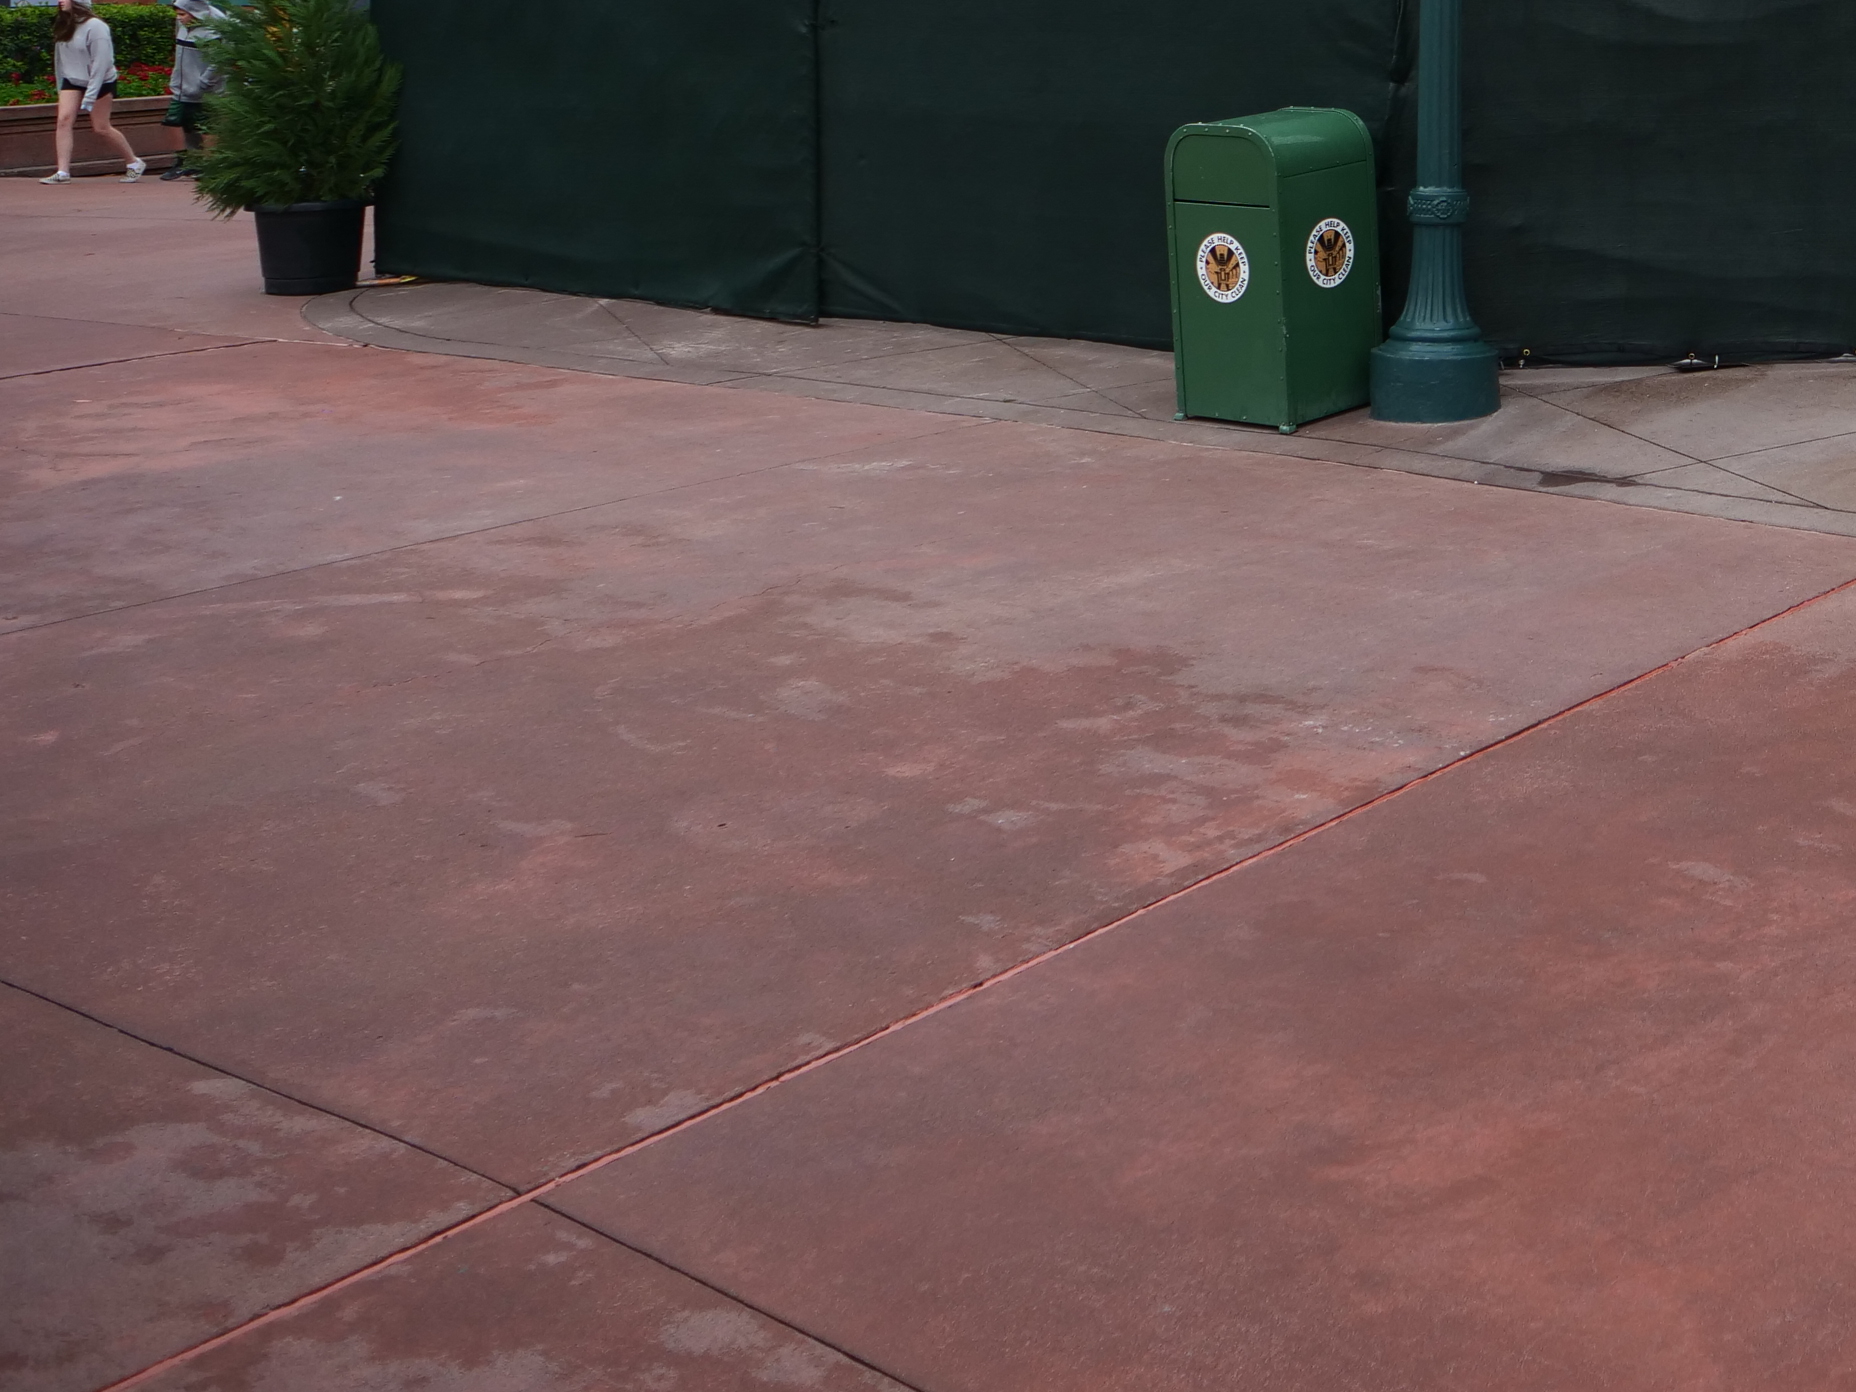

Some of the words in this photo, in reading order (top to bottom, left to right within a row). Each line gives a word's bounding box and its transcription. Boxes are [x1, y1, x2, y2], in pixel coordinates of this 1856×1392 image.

[1199, 237, 1215, 263] PLEASE
[1217, 235, 1235, 245] HELP
[1234, 246, 1246, 266] KEEP
[1308, 225, 1323, 254] PLEASE
[1325, 220, 1341, 228] HELP
[1341, 226, 1352, 245] KEEP
[1309, 265, 1321, 281] OUR
[1322, 277, 1336, 285] CITY
[1338, 256, 1352, 280] CLEAN
[1200, 273, 1213, 291] OUR
[1213, 290, 1229, 300] CITY
[1231, 277, 1246, 298] CLEAN
